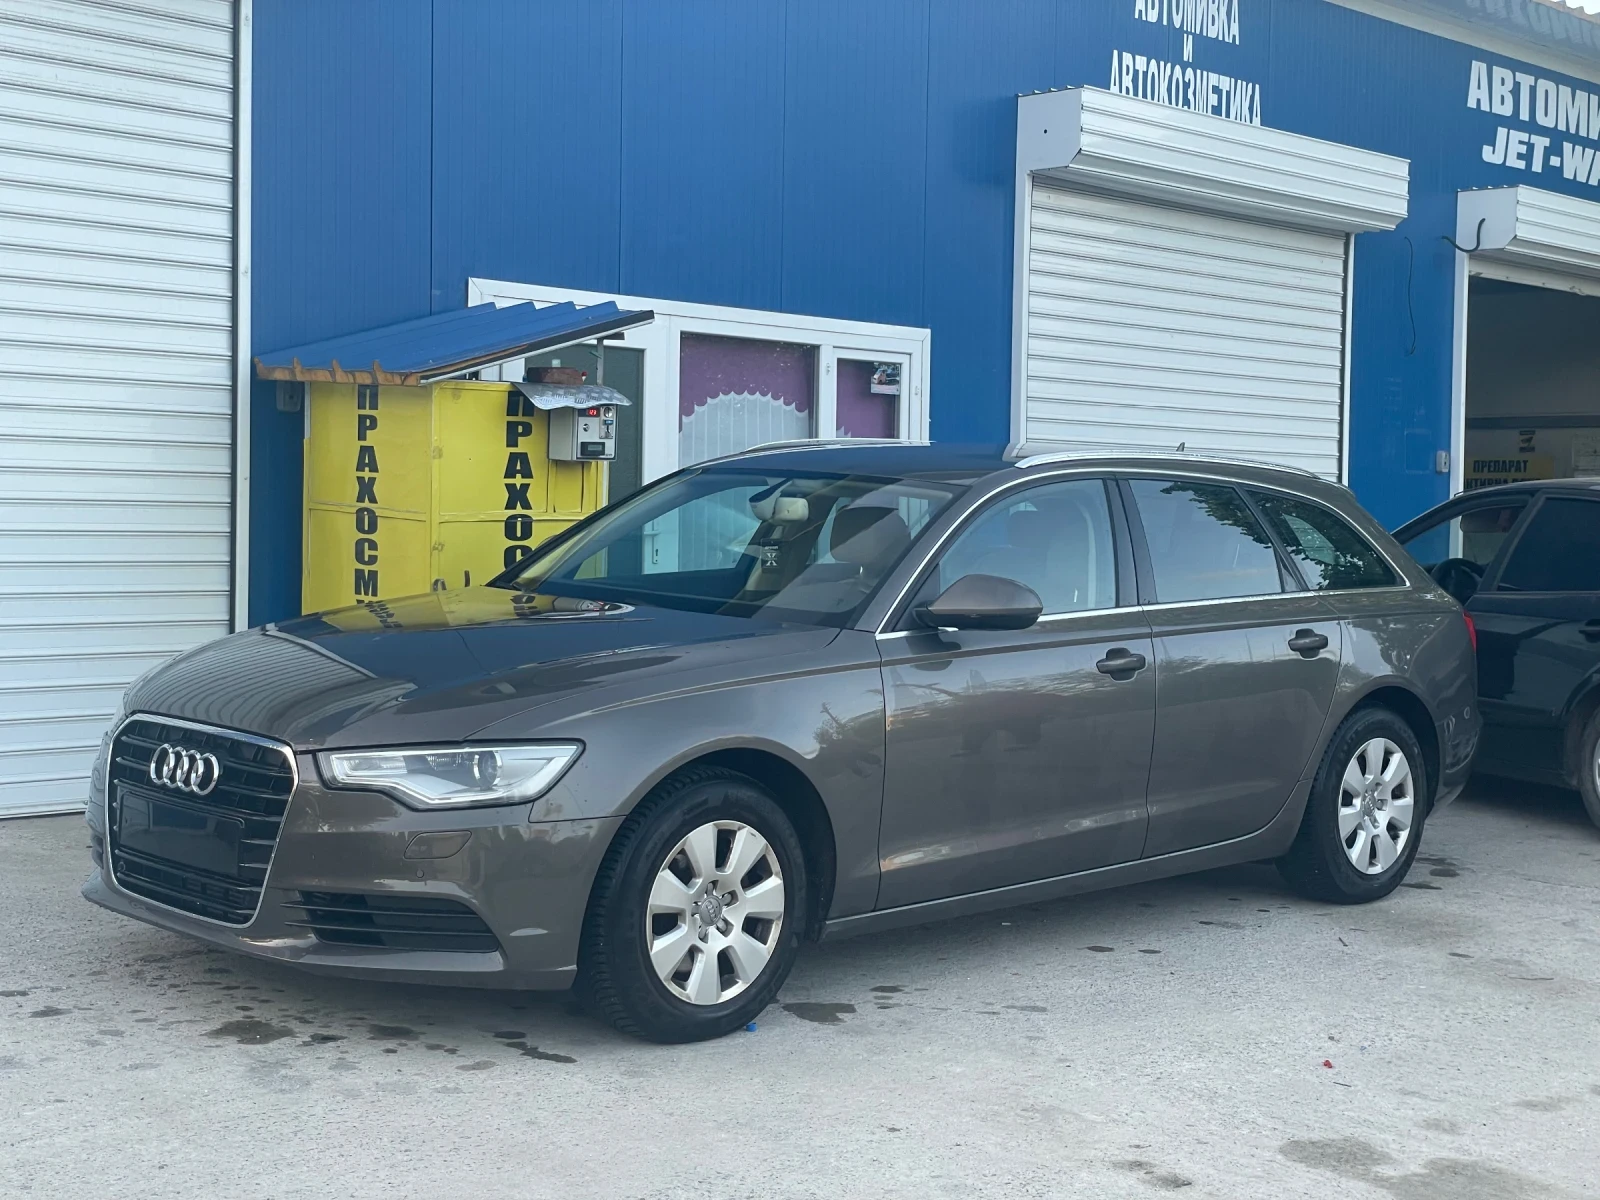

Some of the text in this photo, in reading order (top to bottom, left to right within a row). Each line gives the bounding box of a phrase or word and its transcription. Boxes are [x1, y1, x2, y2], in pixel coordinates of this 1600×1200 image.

[1183, 33, 1193, 62] И
[1109, 49, 1261, 126] АВТОКОЗМЕТИКА
[1473, 460, 1529, 473] ПРЕПАРАТ
[354, 384, 379, 604] ПРАХОСМ
